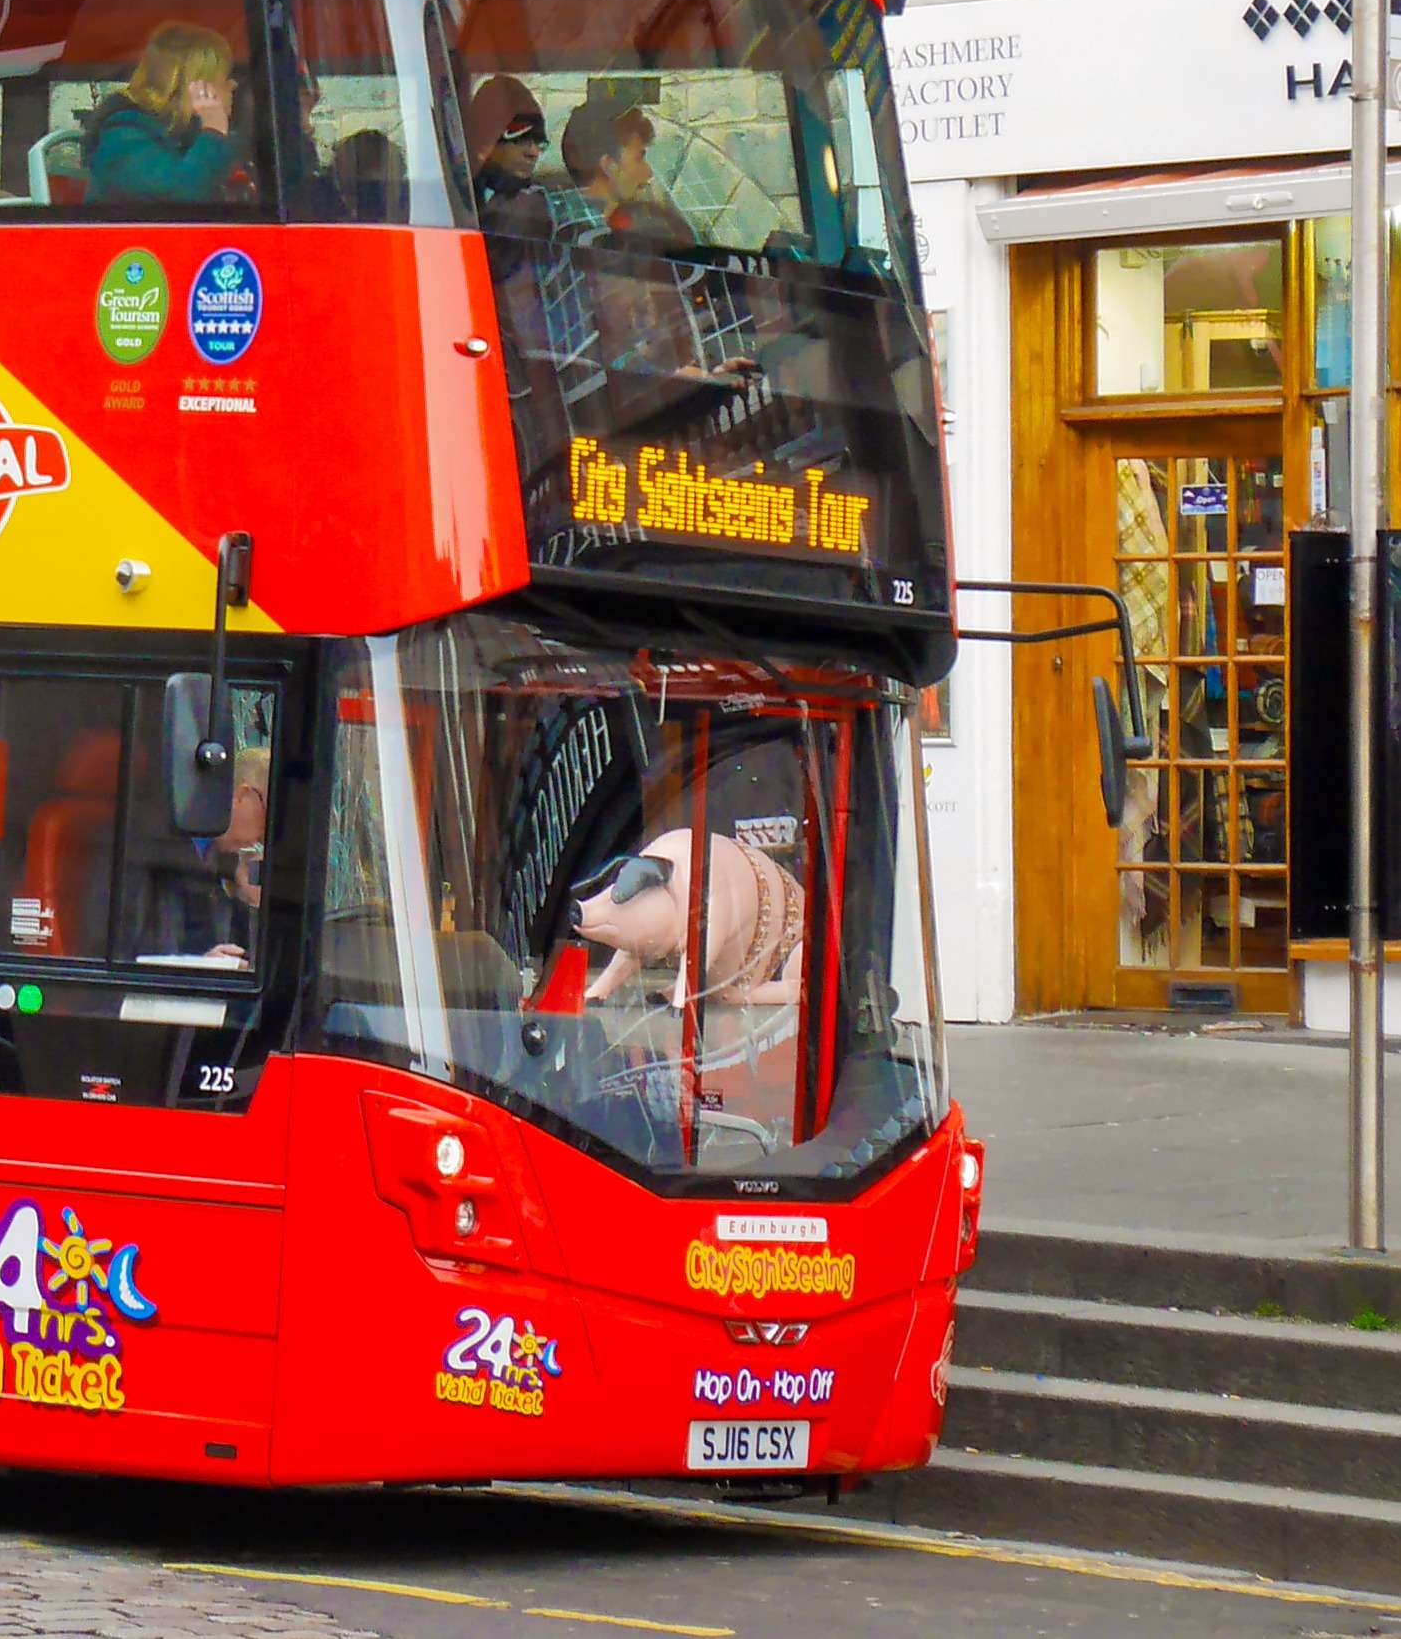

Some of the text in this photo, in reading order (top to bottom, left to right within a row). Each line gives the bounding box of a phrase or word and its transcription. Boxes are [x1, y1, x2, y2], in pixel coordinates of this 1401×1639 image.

[893, 73, 1014, 107] ACTORY
[100, 291, 140, 307] Green
[196, 287, 255, 305] Scottish
[110, 307, 160, 323] Tourism
[208, 341, 235, 351] TOUR
[110, 379, 141, 394] GOLD
[178, 395, 257, 413] EXCEPTIONAL
[570, 435, 870, 552] City Sightseeing Tour
[892, 579, 915, 605] 225
[199, 1065, 236, 1092] 225
[733, 1179, 779, 1194] VOLVO
[728, 1220, 818, 1238] Edinburgh
[685, 1240, 856, 1300] CitySightseeing
[447, 1308, 516, 1378] 24
[11, 1341, 126, 1411] Ticket
[694, 1367, 835, 1405] Hop On Hop Off
[435, 1371, 544, 1417] Valid Ticket
[702, 1426, 797, 1462] SJ16 CSX
